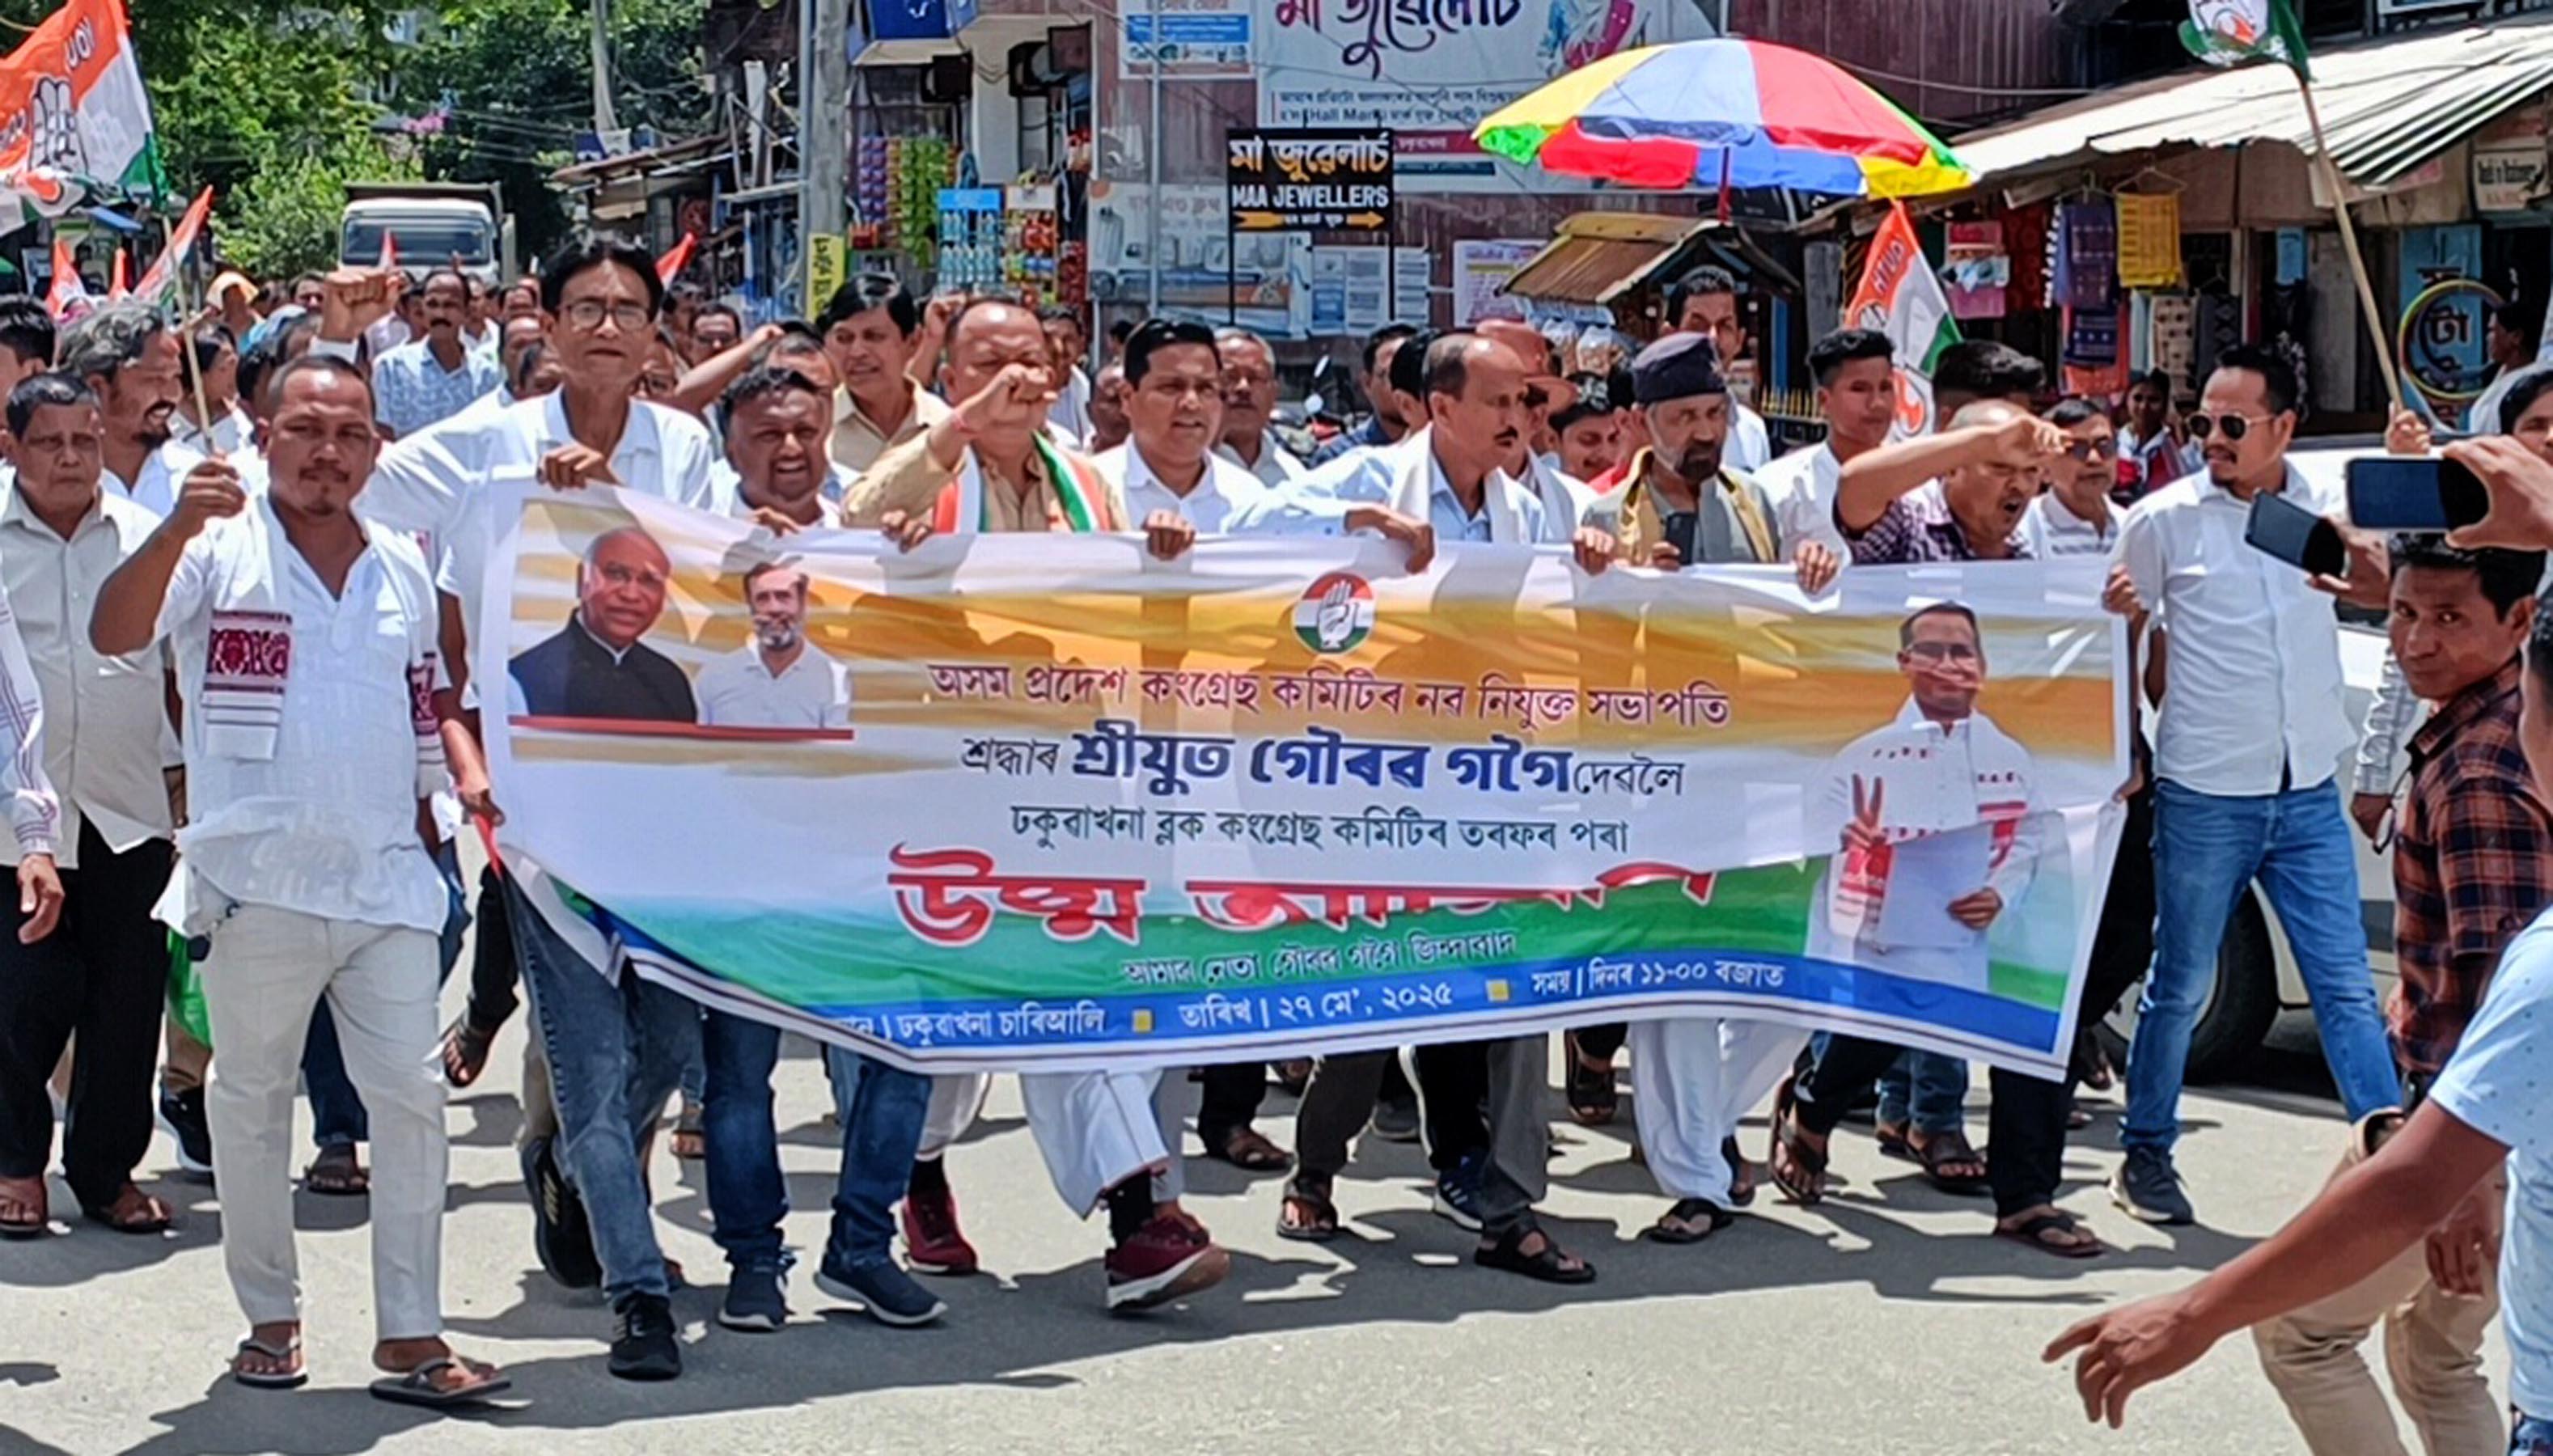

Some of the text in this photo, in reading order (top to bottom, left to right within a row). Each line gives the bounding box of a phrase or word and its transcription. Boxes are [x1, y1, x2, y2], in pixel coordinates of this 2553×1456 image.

[1232, 184, 1268, 207] MAA
[1272, 184, 1389, 208] JEWELLERS
[928, 664, 1011, 700] অসম
[1478, 671, 1577, 730] নিযুক্ত
[1588, 679, 1730, 726] সভাপতি
[1155, 809, 1206, 846] ব্লক
[1570, 819, 1629, 853] পৰা
[1278, 995, 1315, 1024] ২৭
[1382, 981, 1454, 1011] ২০২৫
